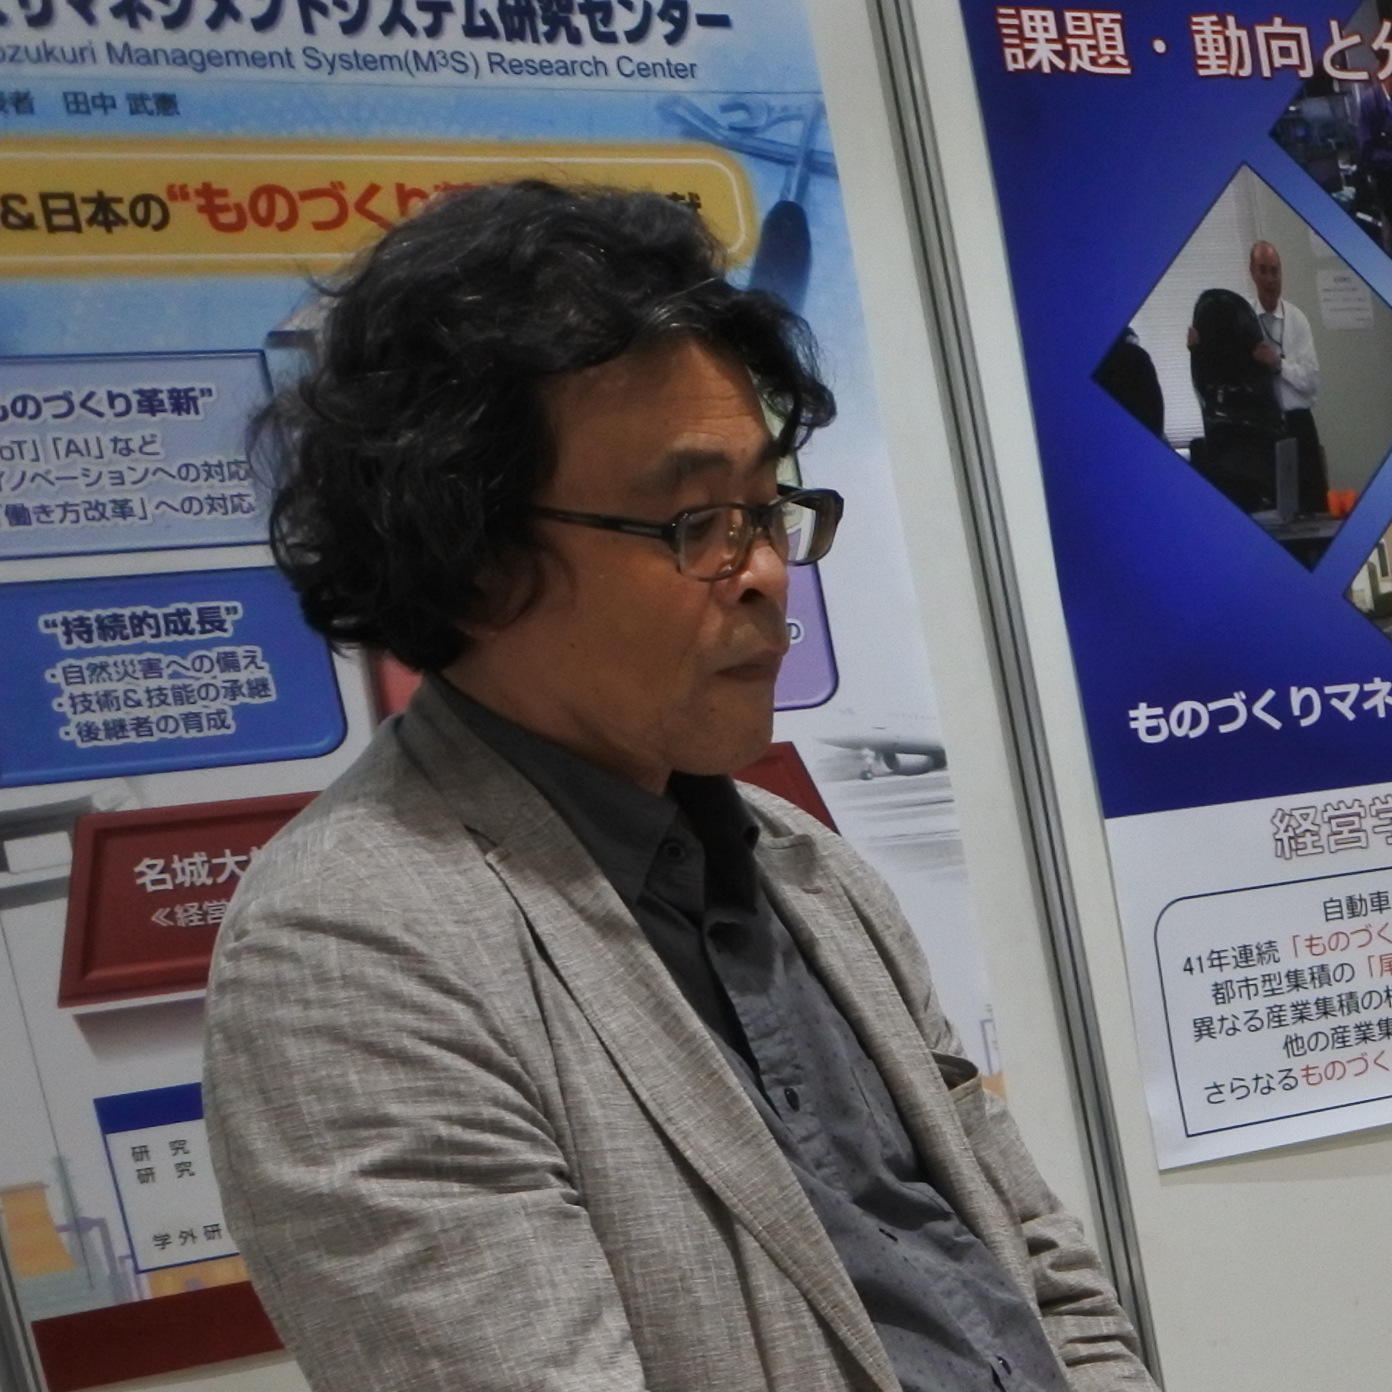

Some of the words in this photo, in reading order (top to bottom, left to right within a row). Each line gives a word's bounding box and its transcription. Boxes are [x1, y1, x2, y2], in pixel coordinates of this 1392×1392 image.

[105, 41, 296, 73] Management
[487, 52, 609, 77] Research
[616, 55, 697, 79] Center
[62, 92, 117, 116] 田中
[0, 387, 213, 422] のづくり革新”
